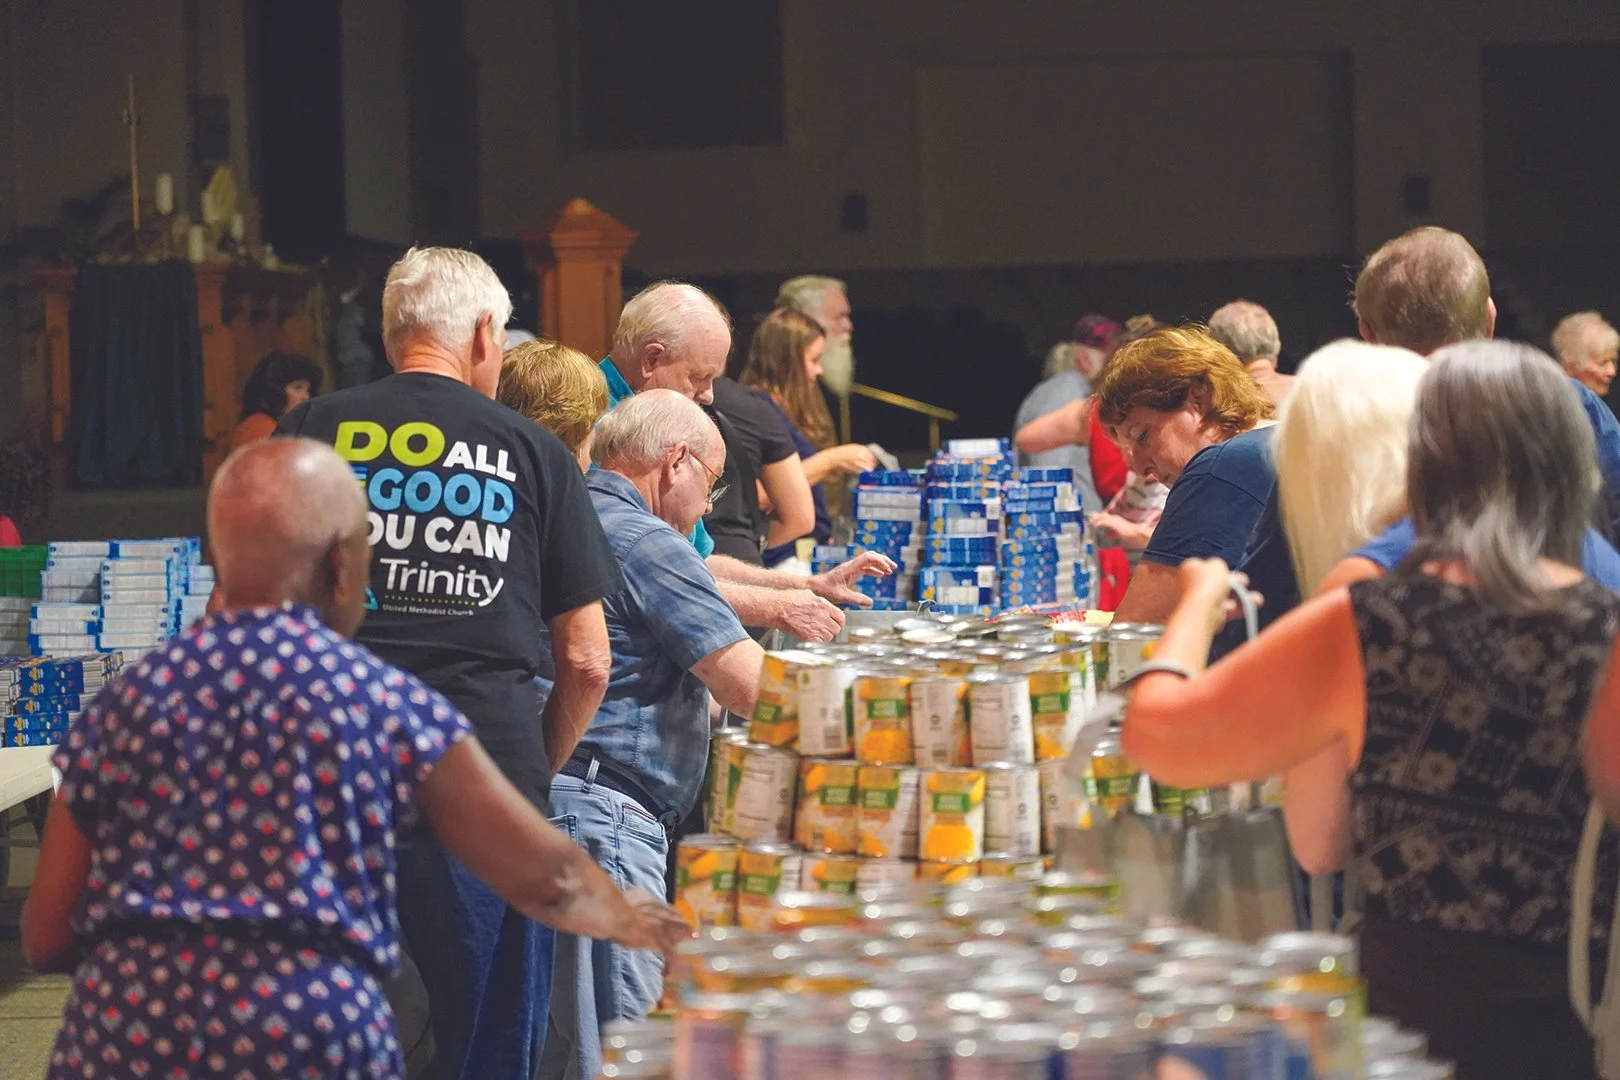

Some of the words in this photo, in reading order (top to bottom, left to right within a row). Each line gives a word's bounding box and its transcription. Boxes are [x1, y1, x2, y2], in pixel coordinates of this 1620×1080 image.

[334, 420, 446, 467] DO
[442, 440, 517, 483] ALL
[367, 466, 515, 524] GOOD
[366, 510, 417, 551] OU
[424, 516, 512, 563] CAN
[379, 557, 505, 608] Trinity
[382, 603, 407, 613] United
[408, 605, 446, 616] Methodist
[447, 608, 475, 617] Church
